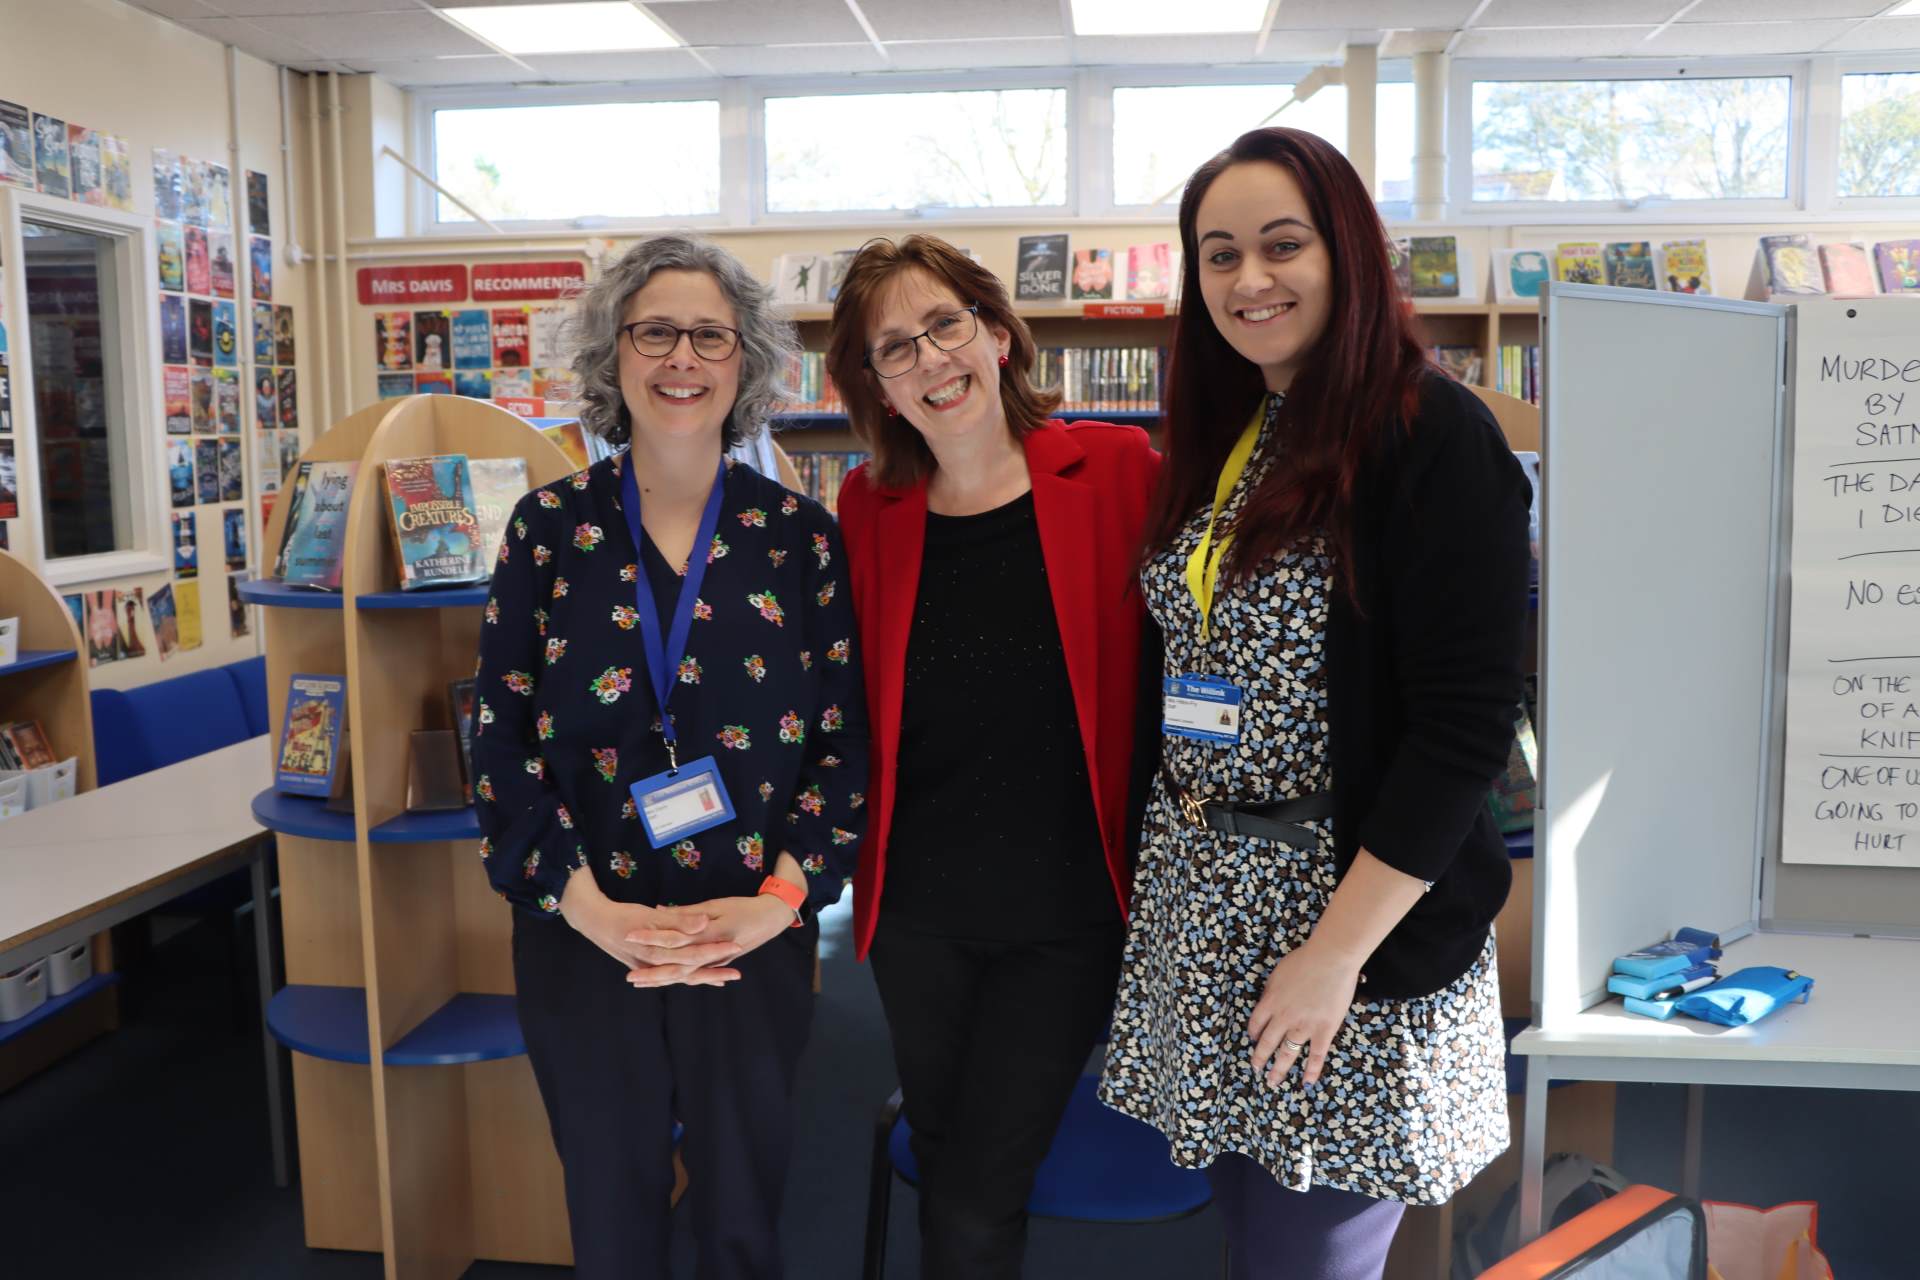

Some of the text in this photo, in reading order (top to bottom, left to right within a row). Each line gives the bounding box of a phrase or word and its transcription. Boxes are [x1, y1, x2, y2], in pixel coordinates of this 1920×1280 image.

[409, 279, 454, 293] DAVIS
[473, 275, 583, 292] RECOMMENDS
[1019, 270, 1062, 282] SILVER
[1020, 281, 1061, 295] BONE
[1103, 305, 1145, 315] FICTION
[1864, 391, 1905, 416] BY
[322, 470, 348, 490] lying
[1823, 472, 1876, 497] THE
[314, 498, 345, 513] about
[409, 499, 462, 513] IMPOSSIBLE
[400, 507, 475, 531] CREATURES
[1845, 579, 1884, 611] NO
[1832, 674, 1912, 696] ON THE
[1860, 702, 1920, 719] OF A
[1820, 765, 1873, 791] ONE
[1876, 766, 1902, 787] OF
[1814, 800, 1919, 822] GOING TO
[1854, 831, 1907, 851] HURT
